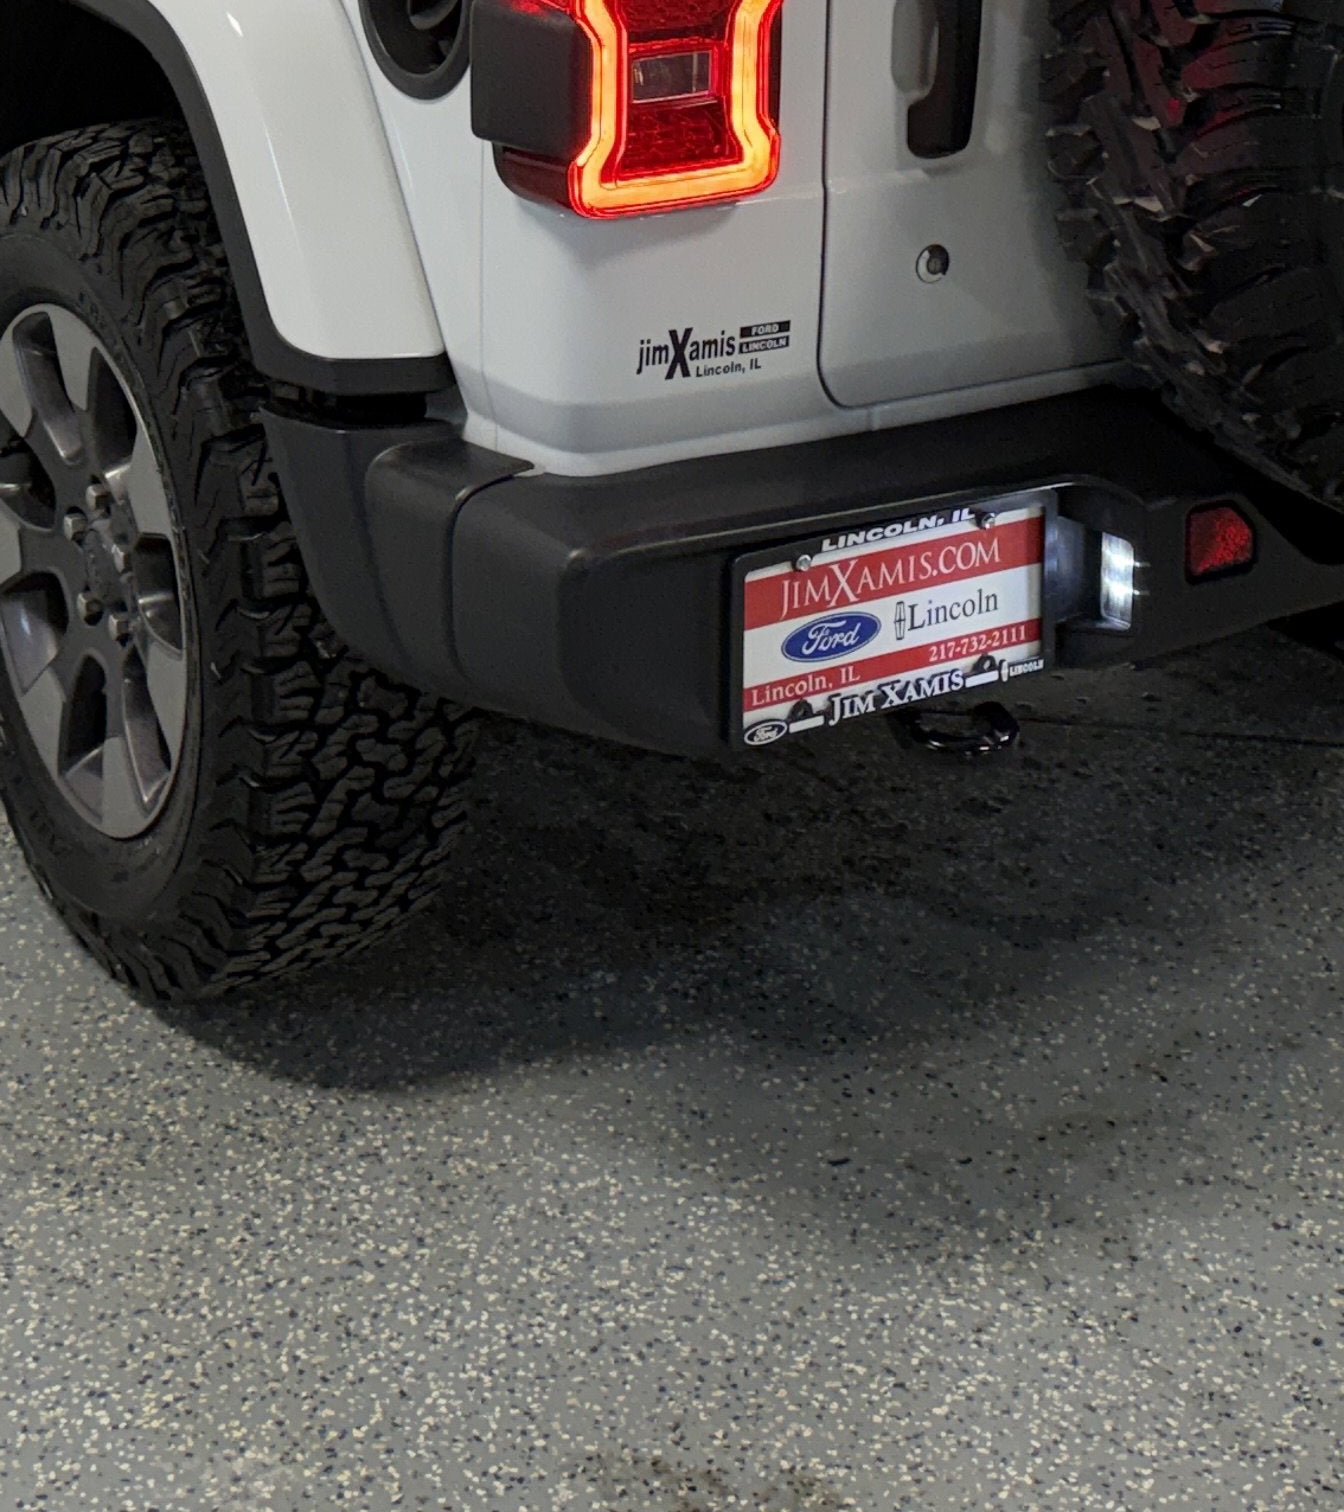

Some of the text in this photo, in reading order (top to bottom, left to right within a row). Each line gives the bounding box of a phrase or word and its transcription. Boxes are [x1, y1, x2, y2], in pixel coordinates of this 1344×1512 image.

[741, 337, 787, 353] LINCOLN
[750, 323, 780, 336] FORD
[695, 358, 762, 378] Lincoln, IL
[821, 507, 976, 552] LINCOLN, IL
[780, 538, 1001, 620] JIMXAMIS.COM
[907, 589, 998, 632] Lincoln
[801, 620, 861, 655] Ford
[928, 624, 1027, 663] 217-732-2111
[751, 665, 862, 706] Lincoln, IL
[828, 669, 965, 727] JIM XAMIS
